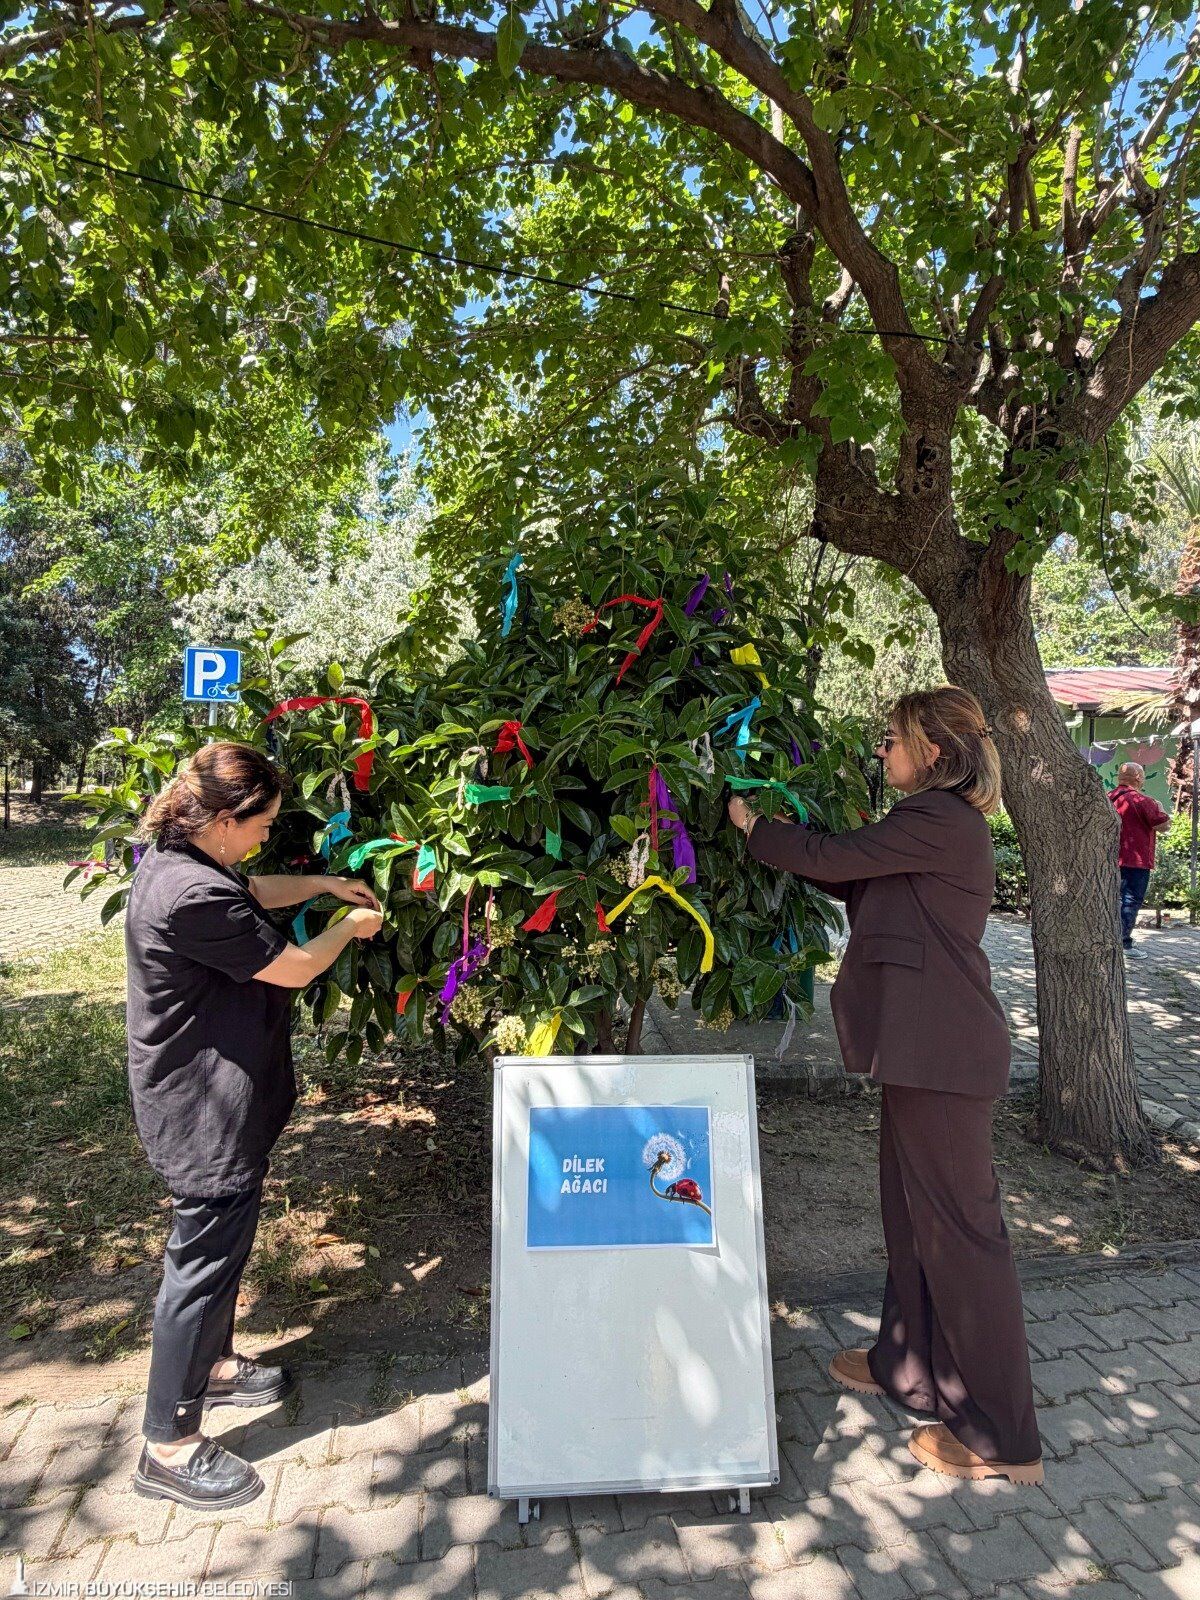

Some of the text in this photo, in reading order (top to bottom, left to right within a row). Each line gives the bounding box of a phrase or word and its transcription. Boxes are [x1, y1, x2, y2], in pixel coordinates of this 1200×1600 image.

[193, 651, 227, 696] P
[562, 1155, 605, 1173] DİLEK
[560, 1175, 607, 1194] AĞACI
